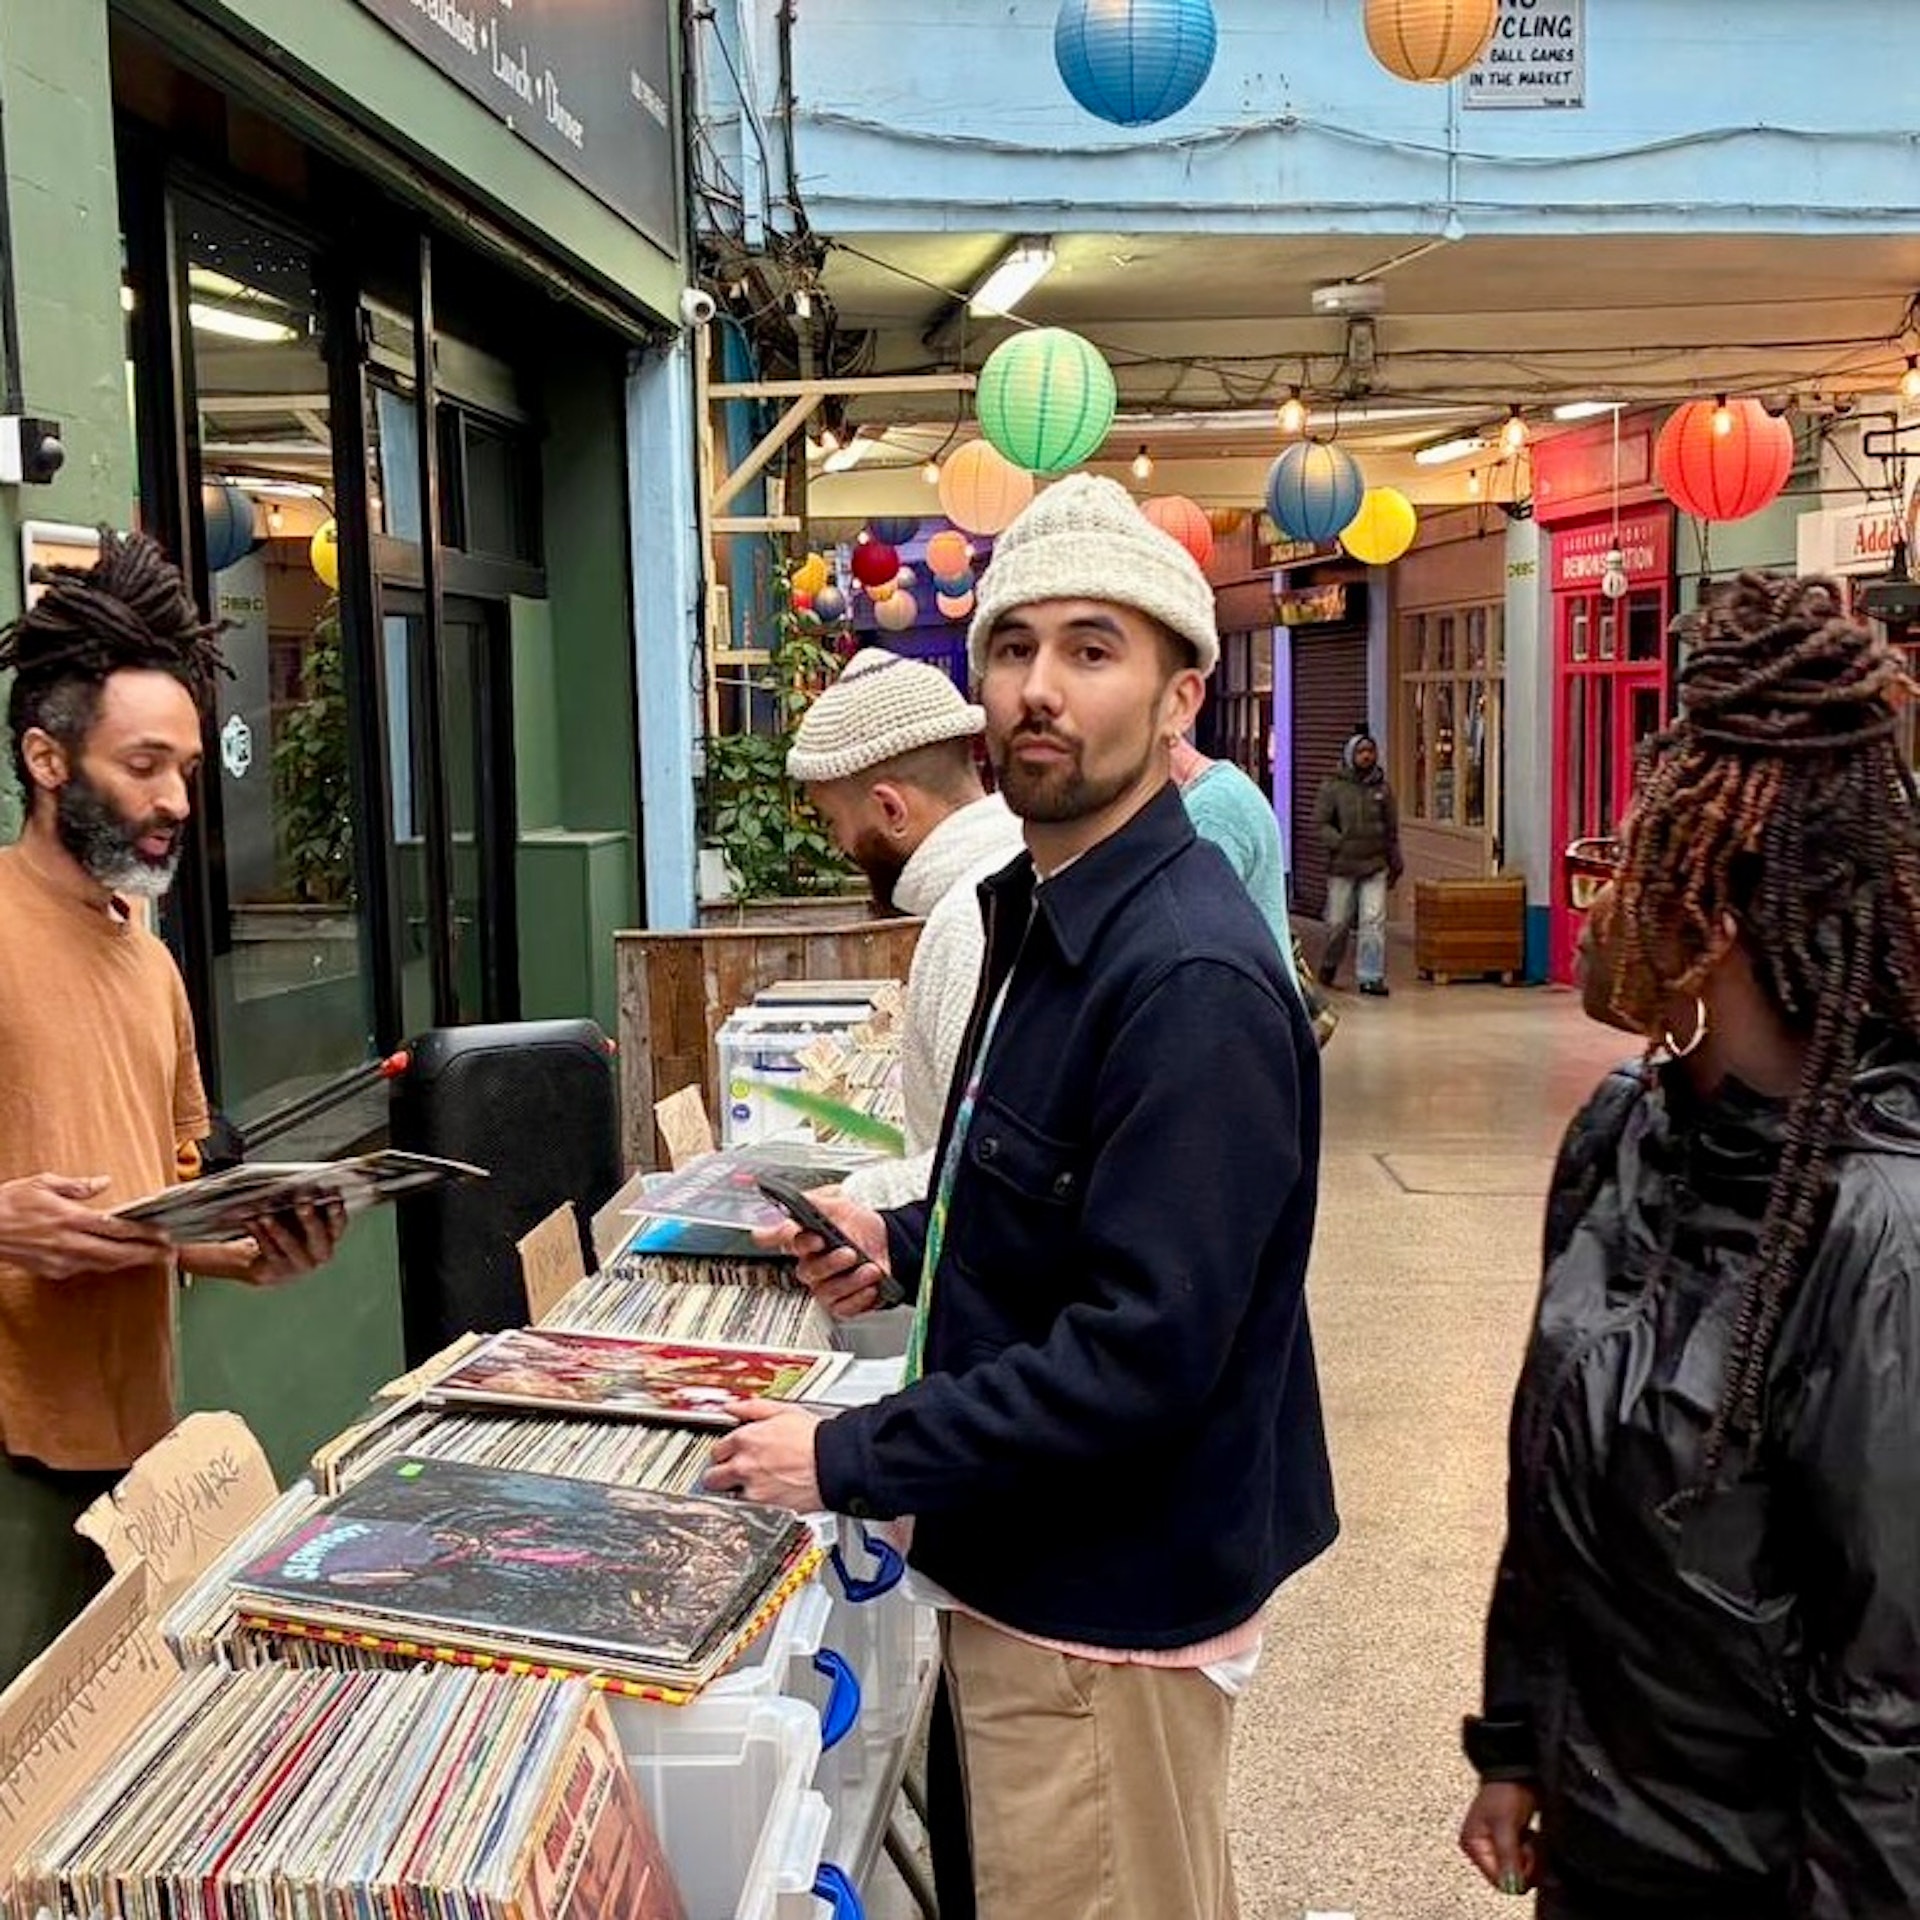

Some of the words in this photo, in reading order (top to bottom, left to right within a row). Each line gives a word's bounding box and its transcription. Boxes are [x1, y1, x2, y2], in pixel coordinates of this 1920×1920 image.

[1491, 15, 1572, 39] YCLING
[1491, 48, 1526, 62] BALL
[1531, 48, 1574, 62] GAMES
[491, 18, 533, 105] Lunch
[545, 69, 583, 150] Dinner
[1470, 73, 1483, 86] IN
[1489, 71, 1512, 86] THE
[1519, 70, 1573, 85] MARKET
[1562, 545, 1656, 580] DEMONSTION
